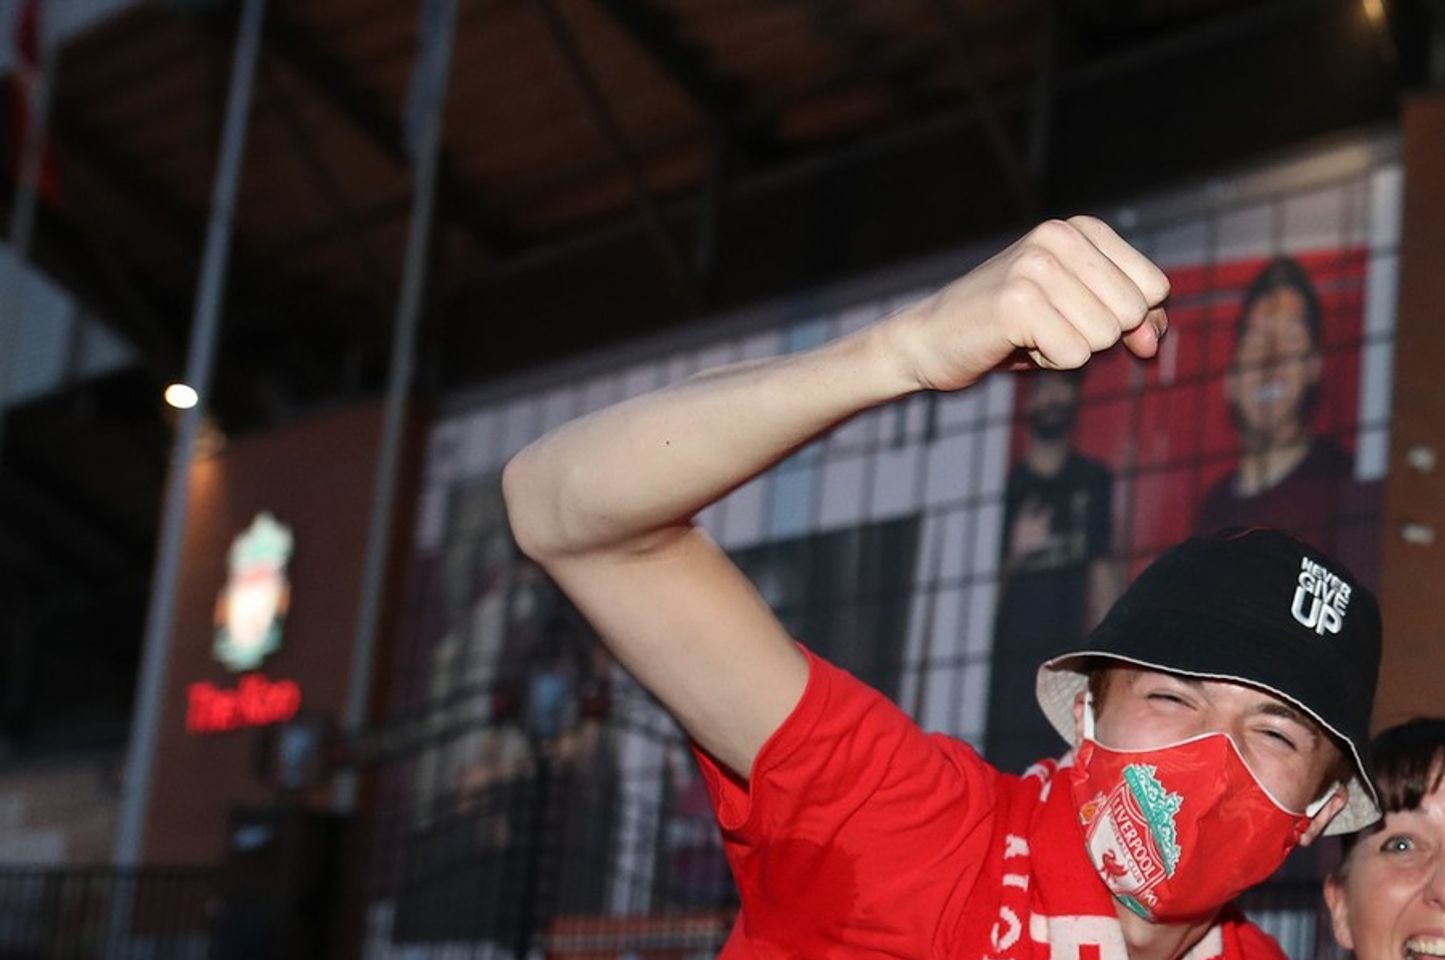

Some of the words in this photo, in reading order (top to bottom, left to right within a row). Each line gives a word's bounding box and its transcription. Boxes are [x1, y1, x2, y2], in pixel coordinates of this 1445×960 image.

[1298, 571, 1349, 617] GIVE
[1301, 556, 1352, 599] NEVER
[1291, 585, 1342, 636] UP
[1111, 797, 1157, 880] LIVERPOOL
